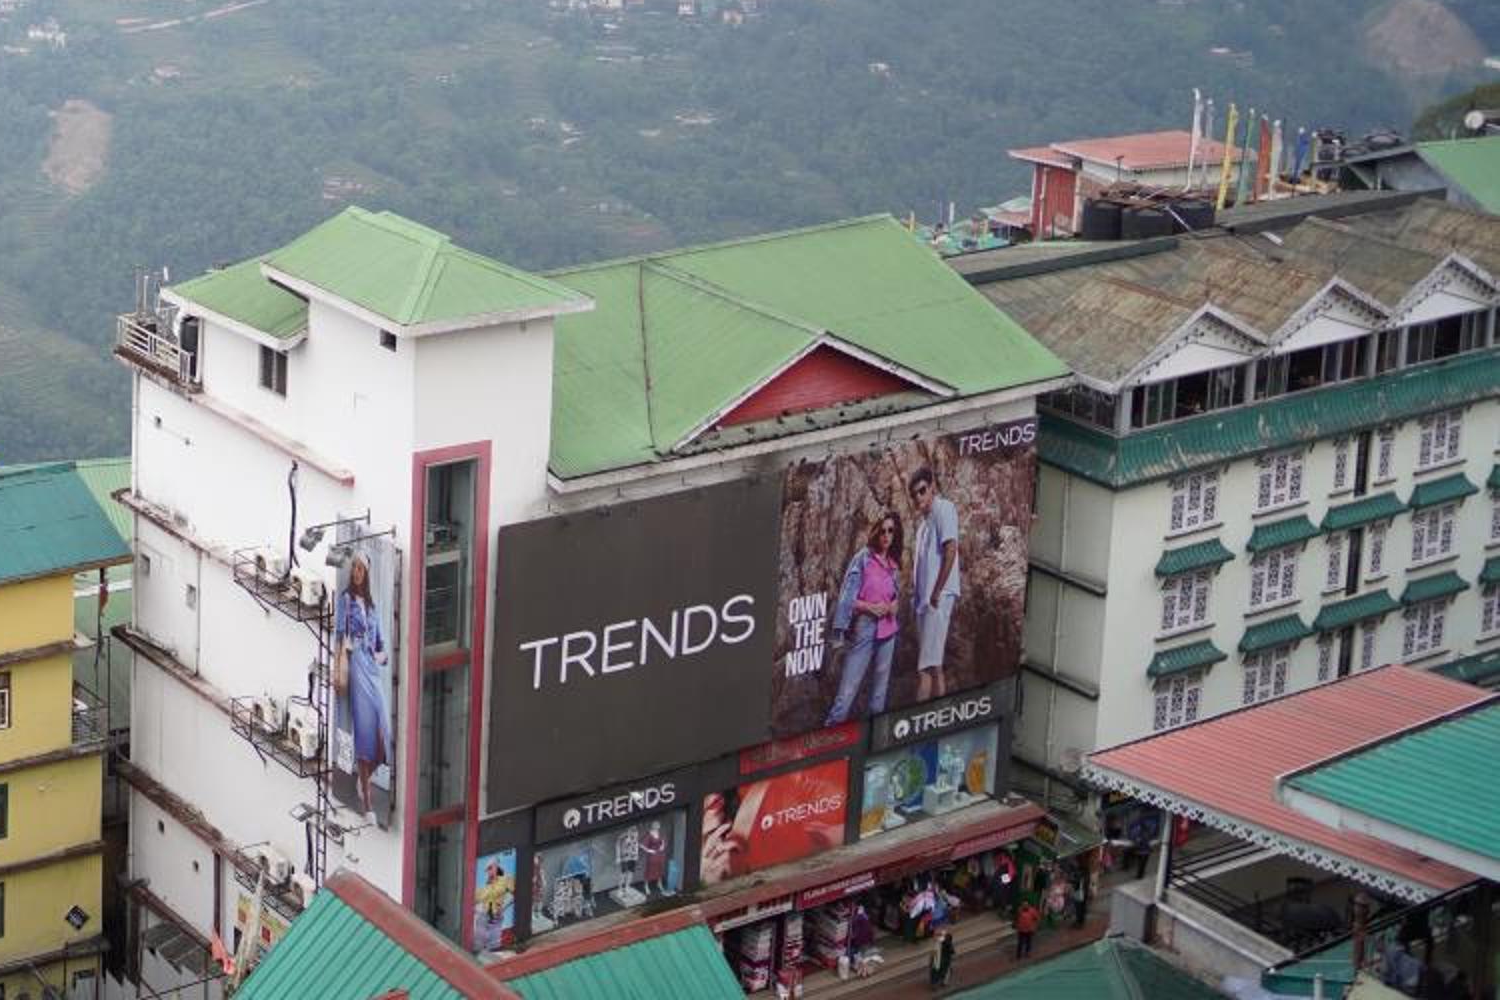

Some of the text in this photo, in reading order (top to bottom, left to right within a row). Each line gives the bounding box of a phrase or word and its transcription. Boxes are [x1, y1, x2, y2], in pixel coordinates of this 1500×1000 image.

[959, 423, 1036, 456] TRENDS
[789, 591, 827, 624] OWN
[519, 594, 756, 690] TRENDS
[794, 617, 826, 649] THE
[784, 644, 825, 678] NOW
[910, 695, 992, 735] TRENDS
[582, 783, 676, 824] TRENDS
[774, 793, 843, 825] TRENDS
